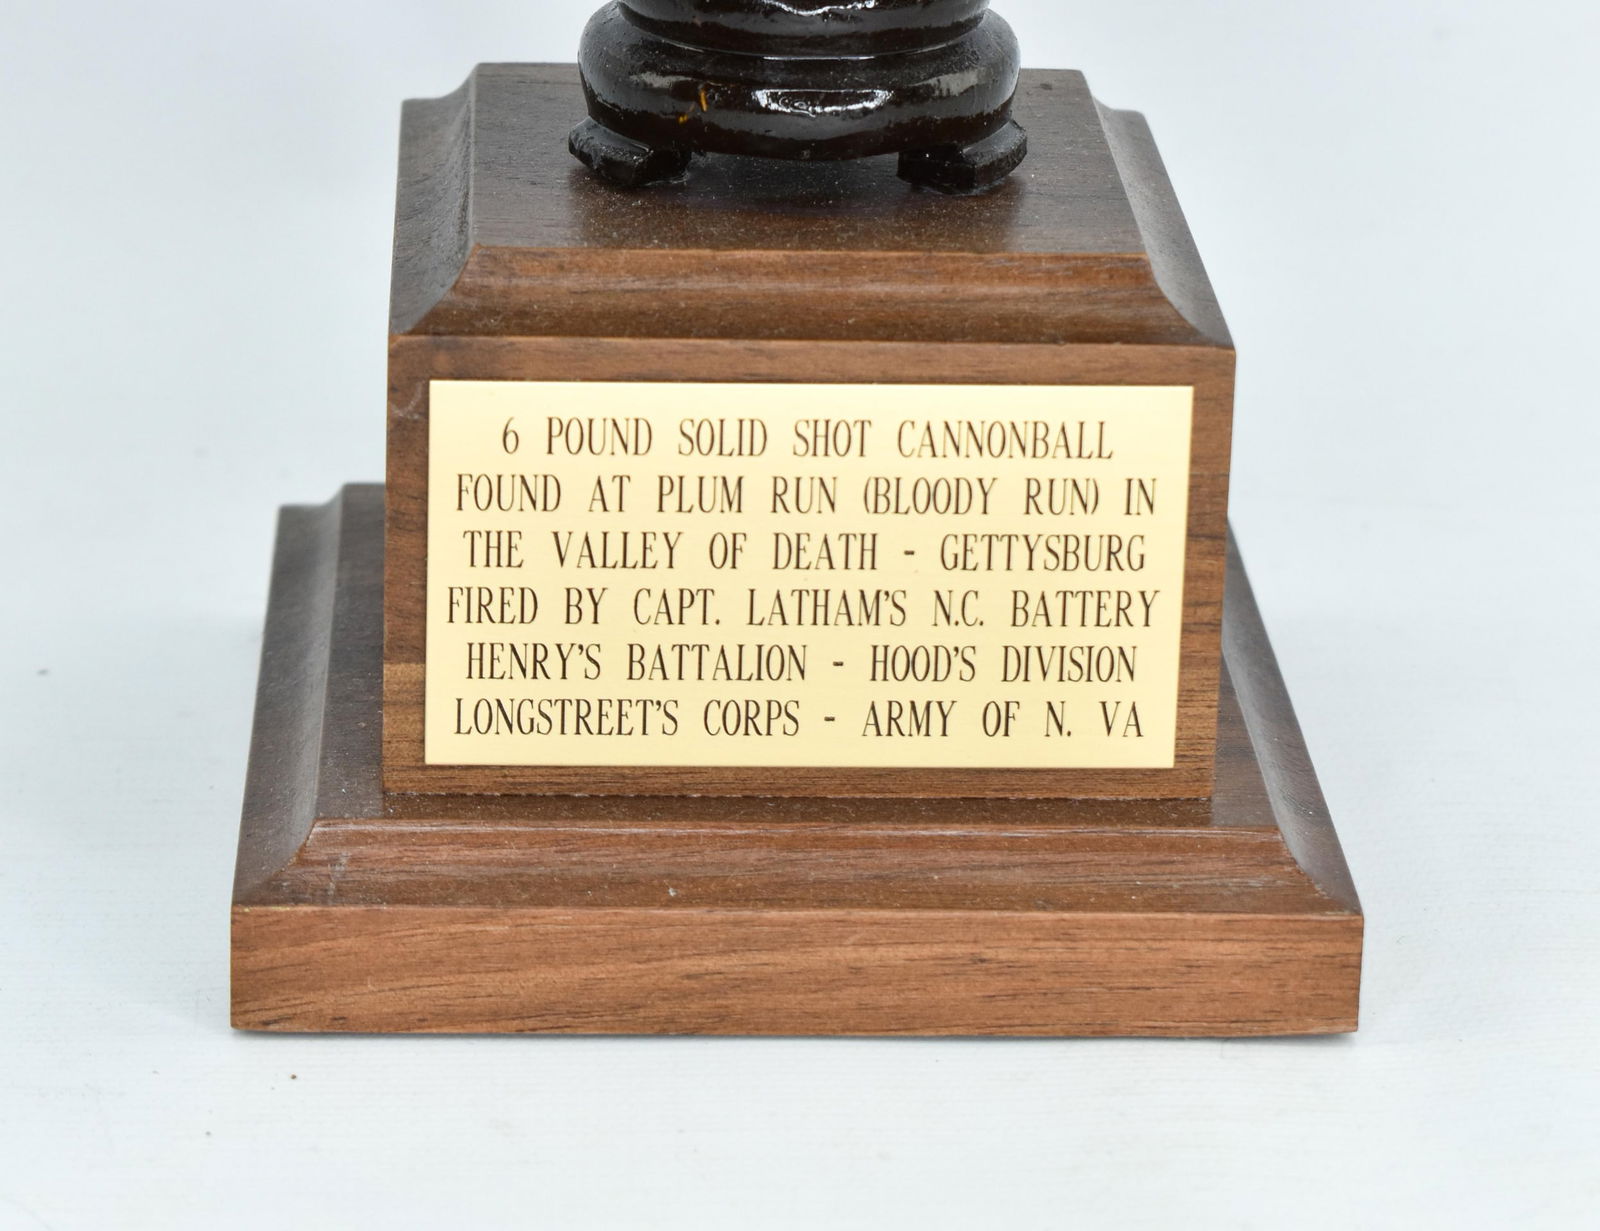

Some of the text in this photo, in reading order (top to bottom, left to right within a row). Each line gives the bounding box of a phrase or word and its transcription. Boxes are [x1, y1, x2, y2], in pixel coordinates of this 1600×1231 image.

[502, 417, 1113, 459] 6 POUND SOLID SHOT CANNONBALL
[457, 474, 1156, 516] FOUND AT PLUM RUN (BLOODY RUN) IN
[463, 530, 524, 568] THE
[552, 531, 682, 569] VALLEY
[709, 532, 747, 570] OF
[773, 532, 877, 571] DEATH
[940, 533, 1145, 572] GETTYSBURG
[448, 586, 1160, 628] FIRED BY CAPT. LATHAM'S N.C. BATTERY
[466, 642, 601, 680] HENRY'S
[627, 643, 807, 682] BATTALION
[870, 644, 976, 682] HOOD'S
[1001, 645, 1138, 683] DIVISION
[454, 698, 679, 736] LONGSTREET'S
[703, 699, 800, 737] CORPS
[862, 700, 957, 737] ARMY
[982, 700, 1020, 738] OF
[1044, 700, 1072, 738] N.
[1099, 701, 1144, 738] VA
